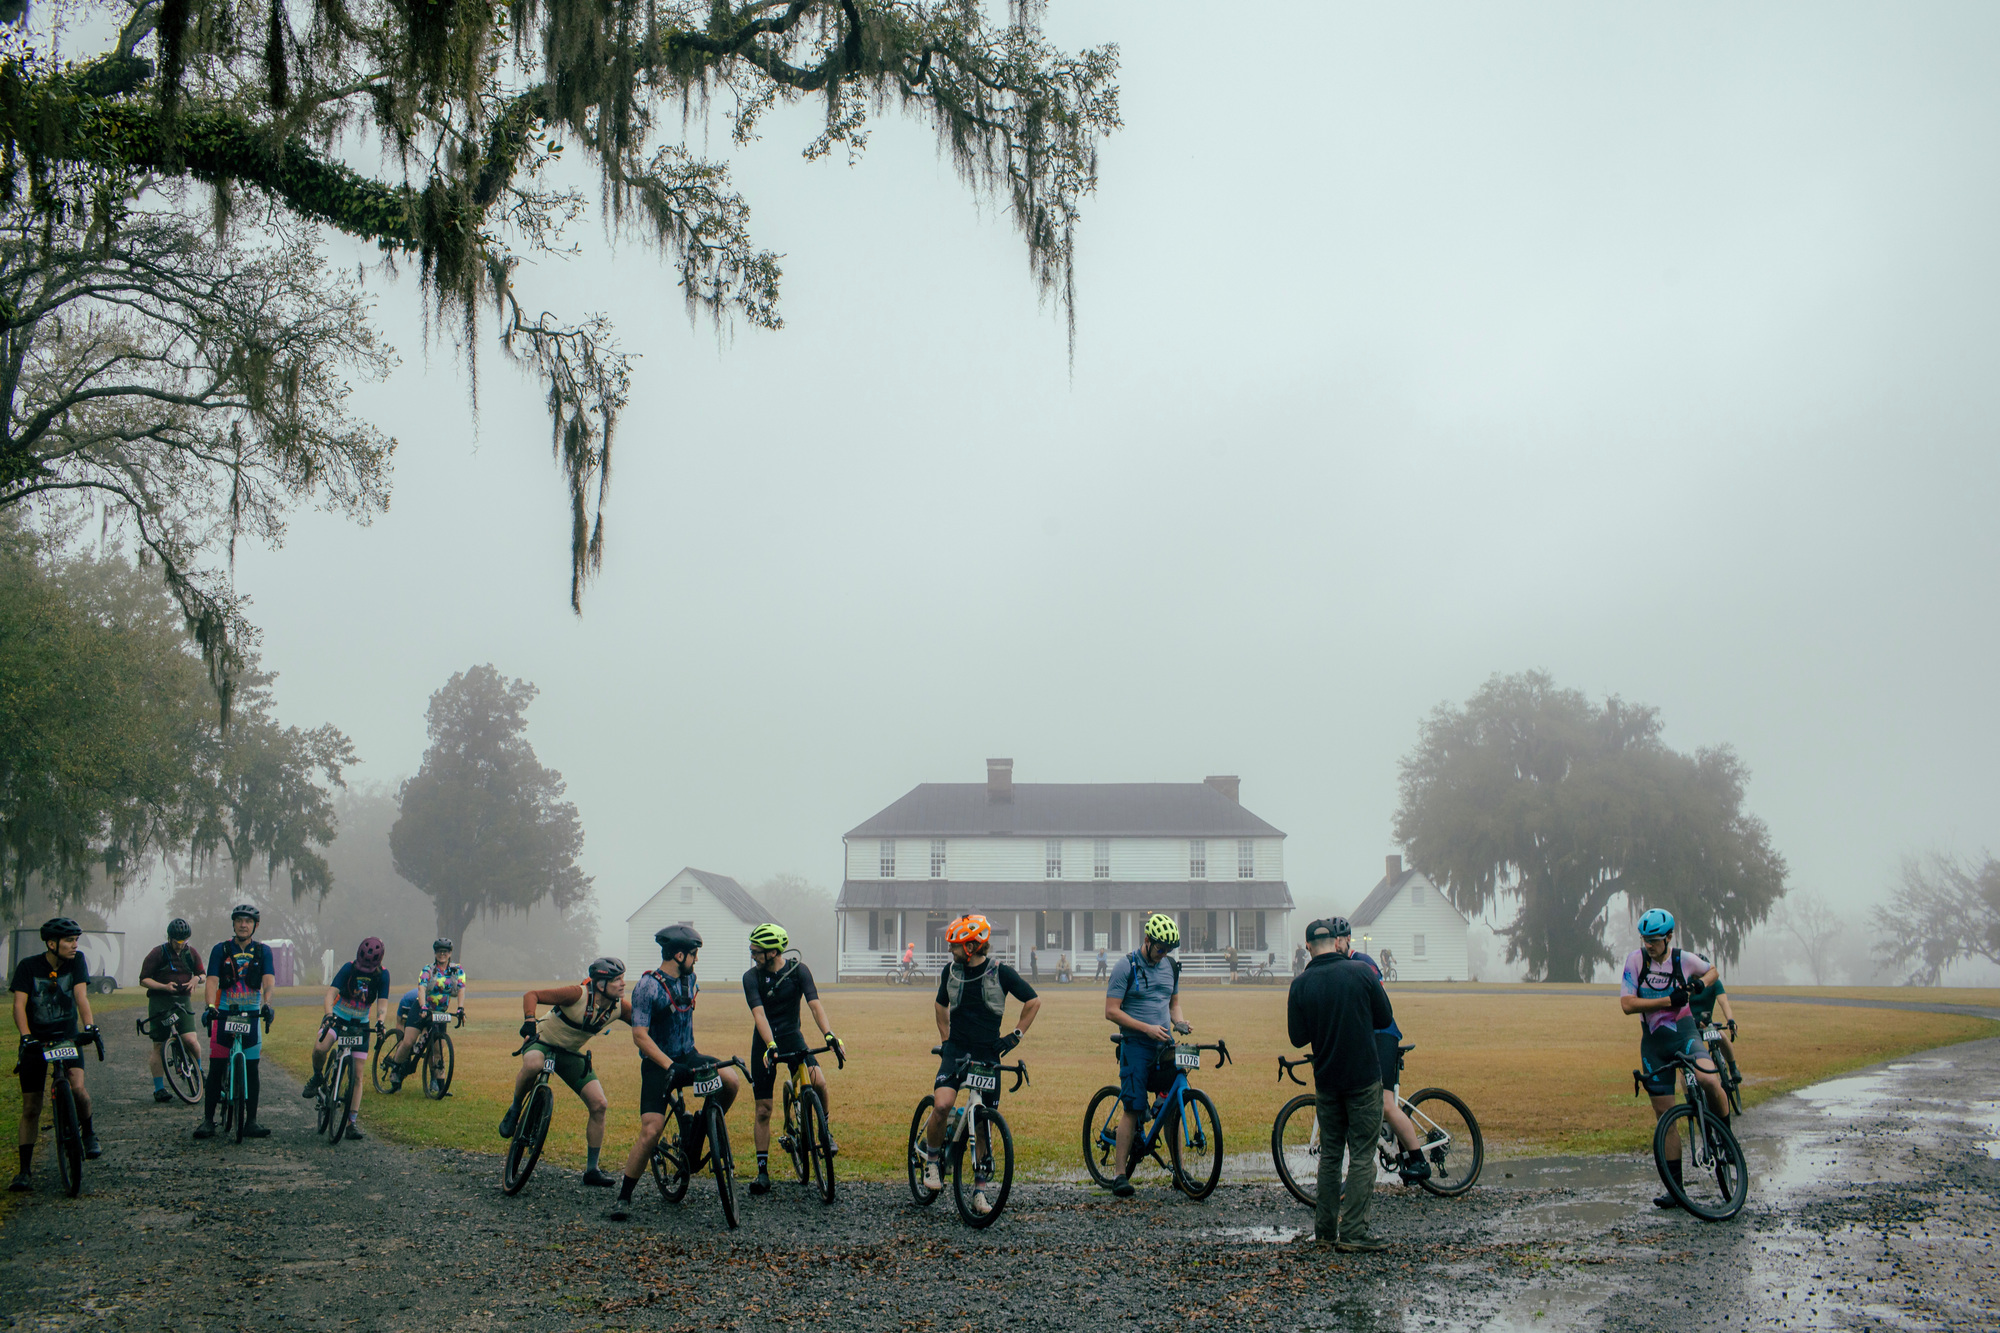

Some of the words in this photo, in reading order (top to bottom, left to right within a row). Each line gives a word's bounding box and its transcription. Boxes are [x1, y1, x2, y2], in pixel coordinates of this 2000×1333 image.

[228, 1022, 249, 1033] 1050
[340, 1036, 361, 1045] 1051
[48, 1047, 75, 1058] 1088
[1178, 1055, 1199, 1066] 1076
[695, 1078, 720, 1093] 1023
[970, 1075, 994, 1088] 1074
